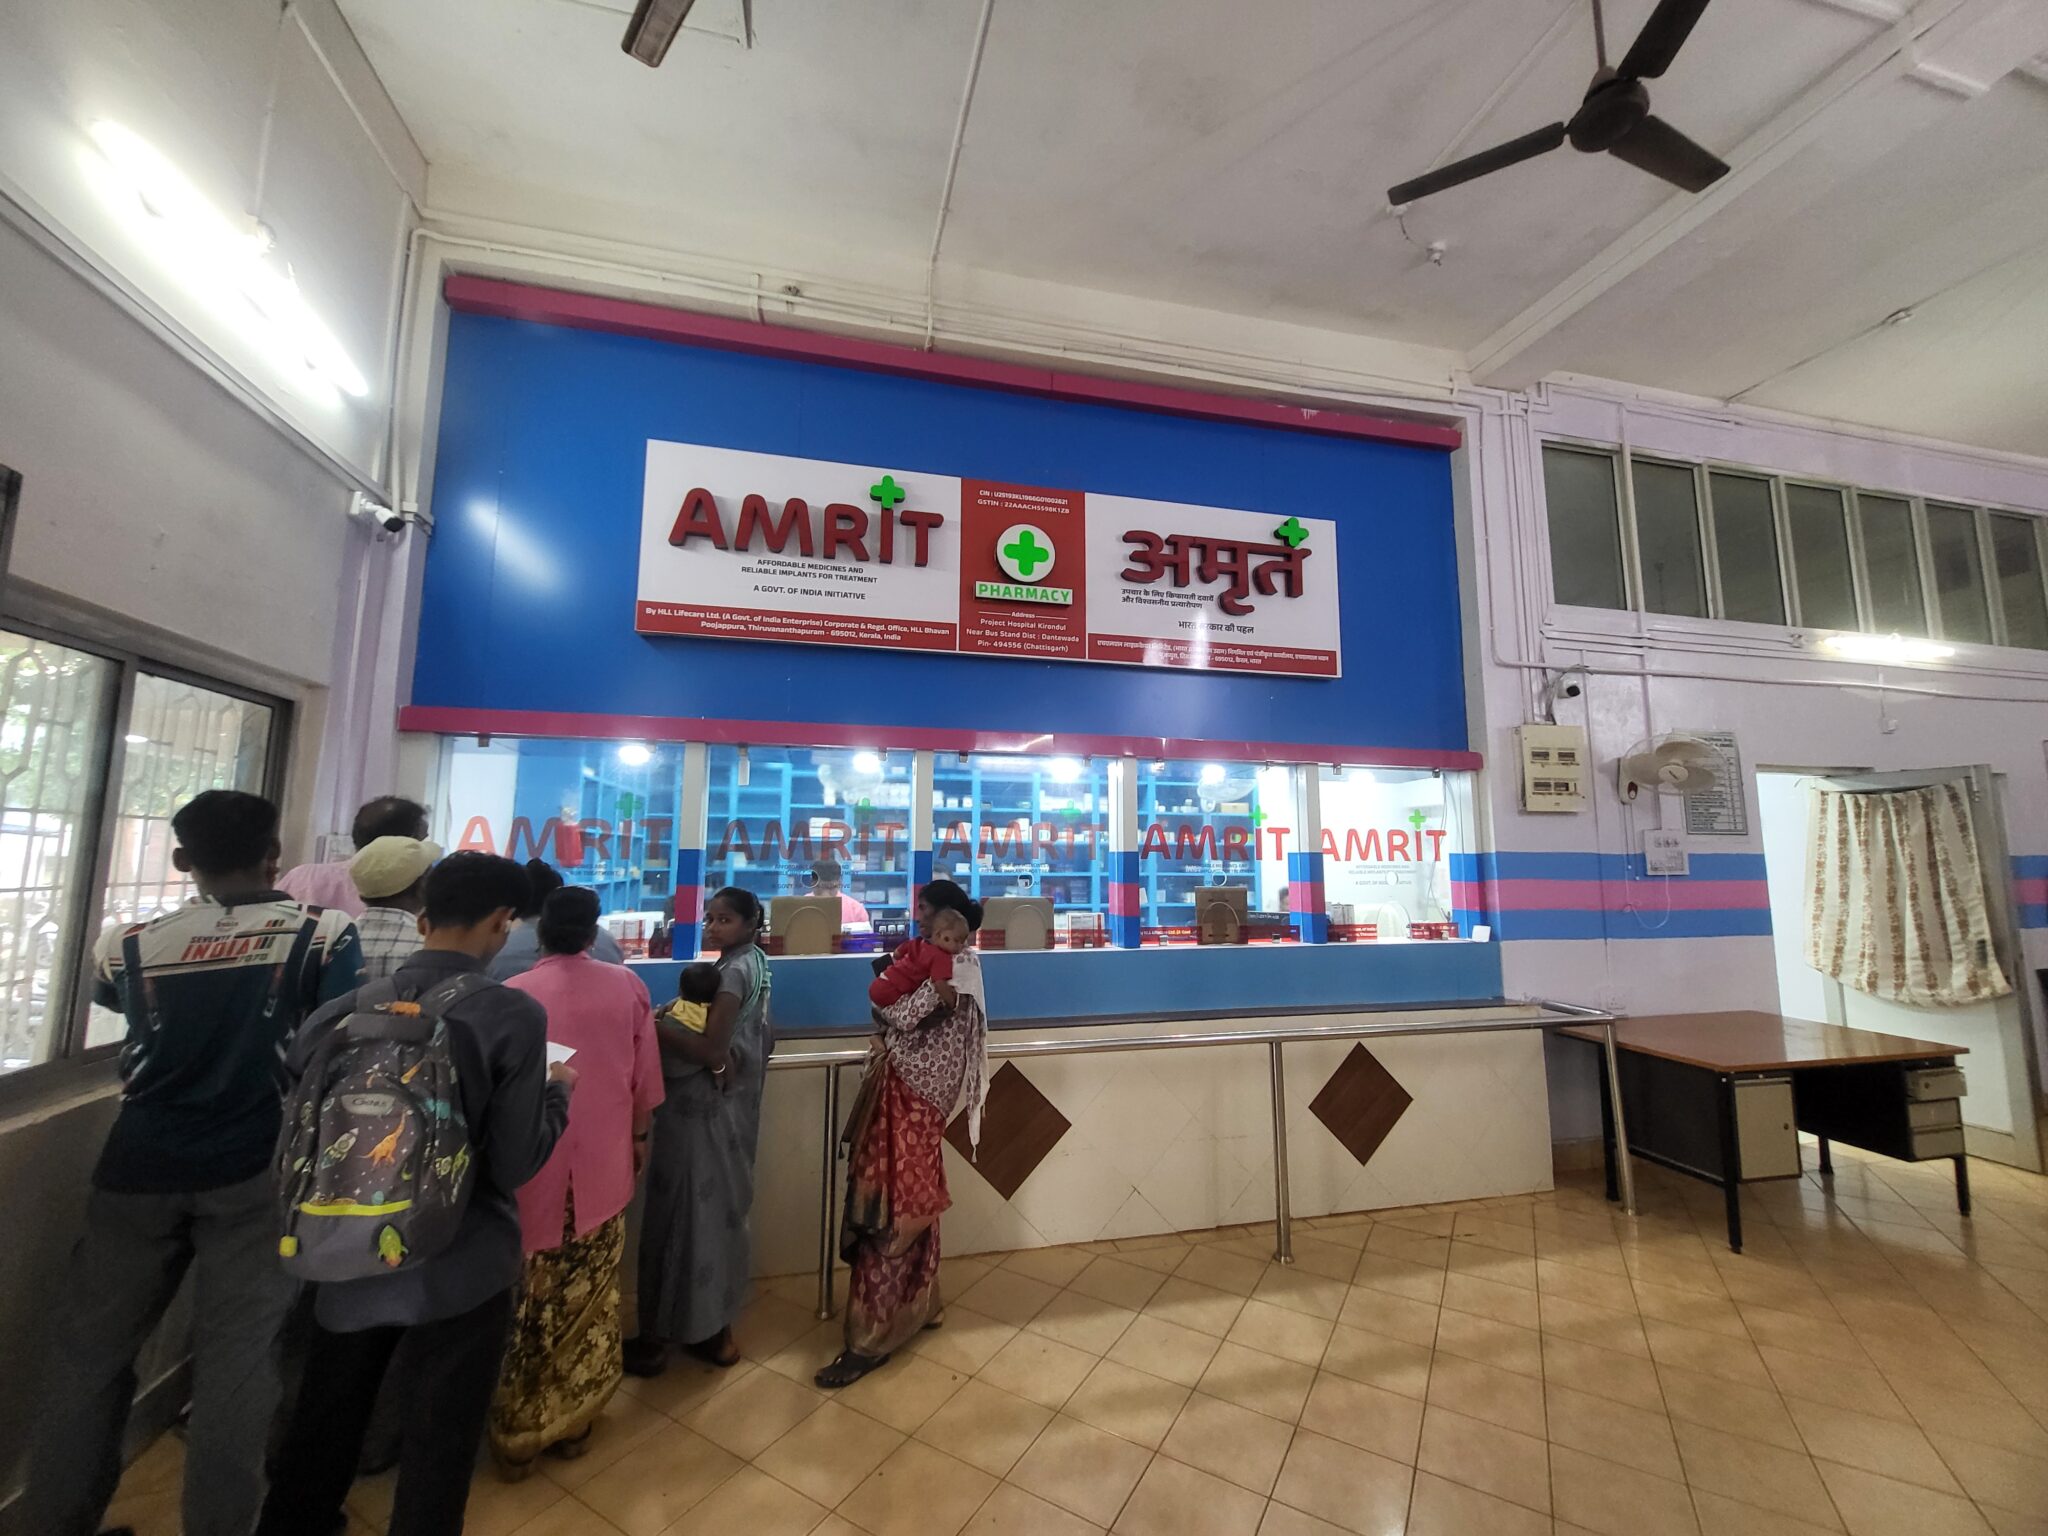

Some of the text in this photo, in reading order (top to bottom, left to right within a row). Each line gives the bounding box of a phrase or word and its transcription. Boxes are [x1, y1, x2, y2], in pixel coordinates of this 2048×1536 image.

[977, 498, 999, 507] GSTIN
[667, 475, 944, 567] AMRIT
[741, 566, 878, 584] RELIABLE IMPLANTS FOR TREATMENT
[757, 559, 864, 574] AFFORDABLE MEDICINES AND
[1120, 517, 1312, 616] अमृत
[753, 584, 866, 600] A GOVT. OF INDIA INITIATIVE
[978, 583, 1070, 602] PHARMACY
[1121, 595, 1134, 604] और
[1143, 588, 1150, 596] के
[1151, 590, 1165, 598] लिए
[645, 607, 656, 616] By
[657, 608, 672, 616] HLL
[674, 609, 705, 618] Lifecare
[722, 613, 731, 621] (A
[732, 613, 752, 622] Govt.
[753, 615, 761, 623] of
[763, 615, 781, 624] India
[782, 617, 823, 627] Enterprise)
[824, 620, 859, 630] Corporate
[867, 623, 887, 632] Regd.
[910, 626, 924, 634] HLL
[924, 627, 950, 635] Bhavan
[980, 618, 1006, 627] Project
[1007, 620, 1036, 629] Hospital
[1011, 611, 1035, 619] Address
[701, 621, 747, 632] Poojappura,
[830, 629, 858, 638] 695012,
[859, 632, 883, 640] Kerala,
[883, 633, 902, 641] India
[966, 628, 983, 636] Near
[985, 629, 998, 637] Bus
[999, 630, 1021, 638] Stand
[1022, 631, 1036, 639] Dist
[1224, 622, 1235, 633] की
[1236, 624, 1255, 635] पहल
[993, 641, 1022, 649] 494556
[1023, 642, 1069, 653] (Chattisgarh)
[454, 792, 674, 860] AMRIT
[716, 797, 906, 861] AMRIT
[938, 801, 1099, 861] AMRIT
[1140, 805, 1290, 861] AMRIT
[1321, 809, 1447, 862] AMRIT
[180, 938, 251, 961] INDIA
